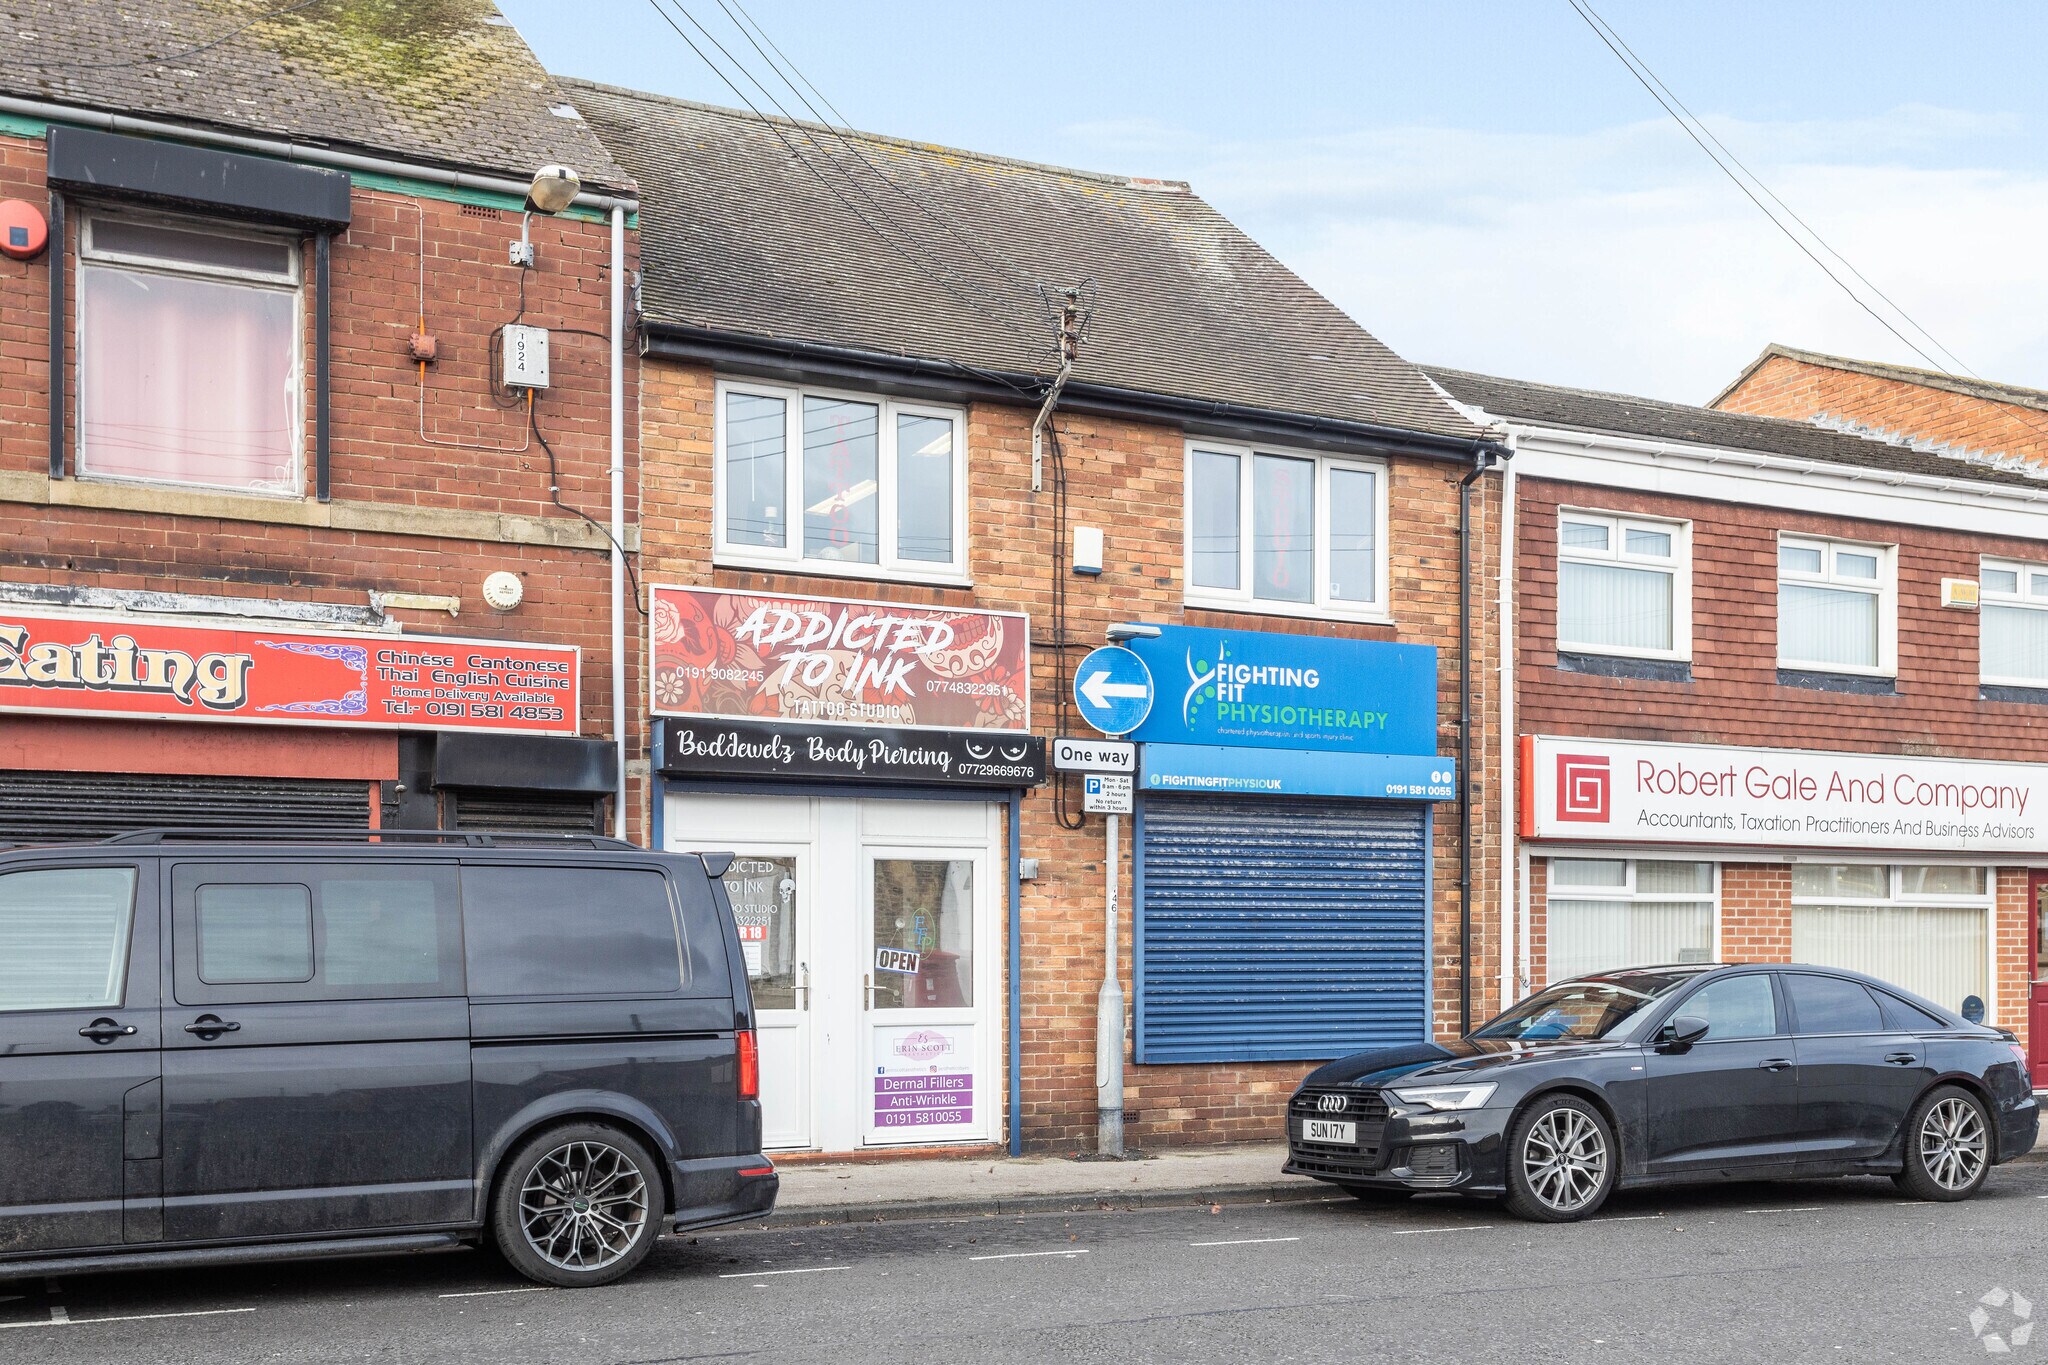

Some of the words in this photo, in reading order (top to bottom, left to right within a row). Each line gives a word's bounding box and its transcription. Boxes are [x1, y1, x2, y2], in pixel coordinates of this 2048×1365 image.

[734, 604, 954, 655] ADDICTED
[377, 650, 454, 667] Chinese
[468, 655, 569, 672] Cantonese
[376, 667, 419, 681] Thai
[432, 670, 499, 687] English
[505, 674, 569, 690] Cuisine
[675, 666, 706, 679] 0191
[710, 668, 764, 682] 9082245
[778, 648, 834, 690] TO
[841, 650, 919, 697] INK
[1217, 663, 1320, 689] FIGHTING
[392, 686, 431, 698] Home
[435, 688, 488, 702] Delivery
[493, 691, 554, 704] Available
[926, 680, 1008, 697] 07748322951
[1217, 683, 1246, 702] FIT
[426, 702, 465, 717] 0191
[471, 704, 503, 718] 581
[509, 706, 564, 721] 4853
[793, 699, 845, 717] TATTOO
[850, 702, 900, 720] STUDIO
[1217, 702, 1388, 730] PHYSIOTHERAPY
[807, 736, 867, 771] Body
[869, 738, 952, 773] Piercing
[1061, 746, 1092, 761] One
[1099, 752, 1129, 766] way
[958, 763, 1034, 778] 07729669676
[1090, 780, 1099, 793] P
[1162, 775, 1281, 789] FIGHTINGFITPHYSIOUK
[1386, 784, 1407, 794] 0191
[1410, 785, 1426, 795] 581
[1428, 786, 1452, 796] 0055
[1637, 760, 1737, 797] Robert
[1745, 766, 1817, 801] Gale
[1826, 770, 1884, 804] And
[1894, 773, 2029, 816] Company
[1637, 809, 1736, 830] Accountants,
[1740, 813, 1800, 832] Taxation
[1806, 815, 1890, 835] Practitioners
[1893, 819, 1922, 836] And
[1926, 820, 1979, 838] Business
[1982, 822, 2035, 840] Advisors
[729, 861, 774, 873] DICTED
[744, 904, 778, 914] STUDIO
[736, 915, 771, 926] 322951
[749, 926, 762, 939] 18
[879, 950, 917, 972] OPEN
[896, 1045, 918, 1053] ERIN
[921, 1044, 951, 1052] SCOTT
[884, 1077, 926, 1090] Dermal
[930, 1076, 964, 1088] Fillers
[890, 1094, 957, 1106] Anti-Wrinkle
[886, 1113, 911, 1124] 0191
[916, 1111, 962, 1123] 5810055
[1311, 1122, 1328, 1138] SUN
